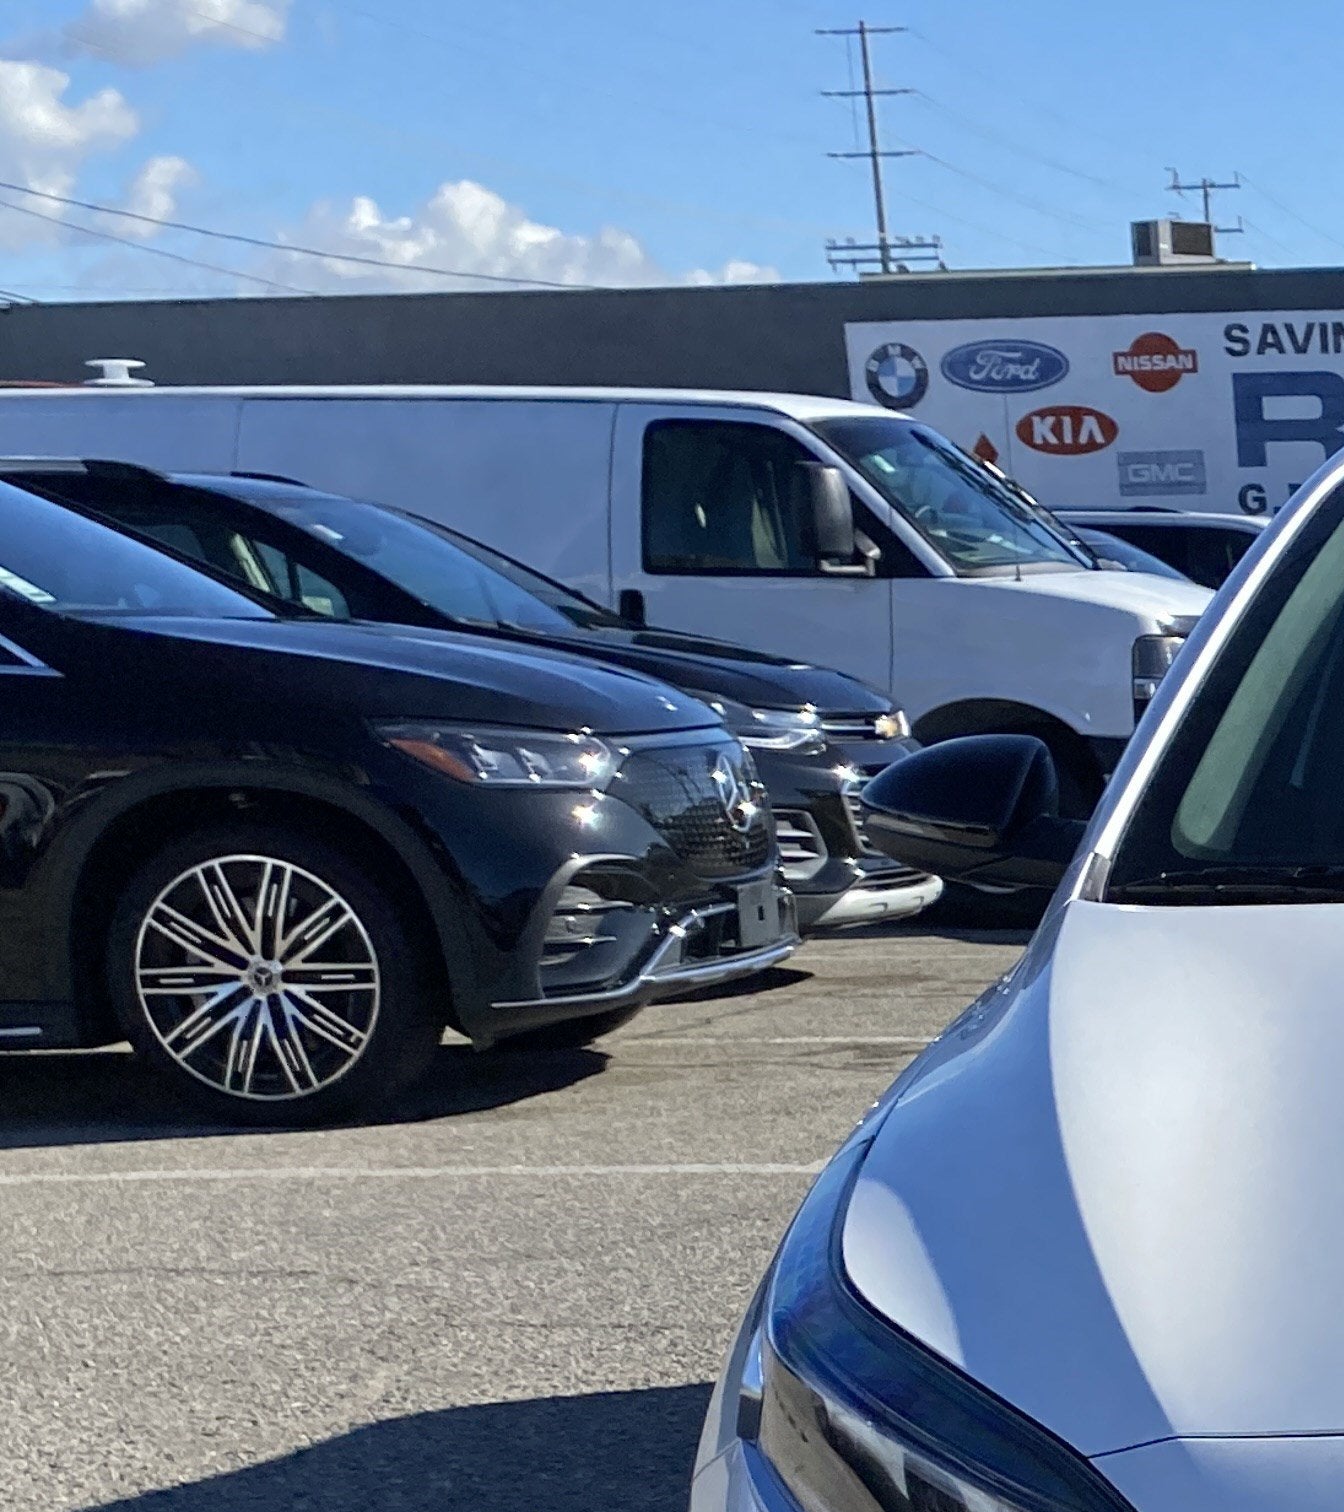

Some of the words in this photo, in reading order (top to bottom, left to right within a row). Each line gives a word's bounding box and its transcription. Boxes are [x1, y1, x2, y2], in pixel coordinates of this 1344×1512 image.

[968, 350, 1040, 380] Ford
[1118, 354, 1193, 371] NISSAN
[1032, 415, 1104, 444] KIA
[1127, 463, 1195, 482] GMC
